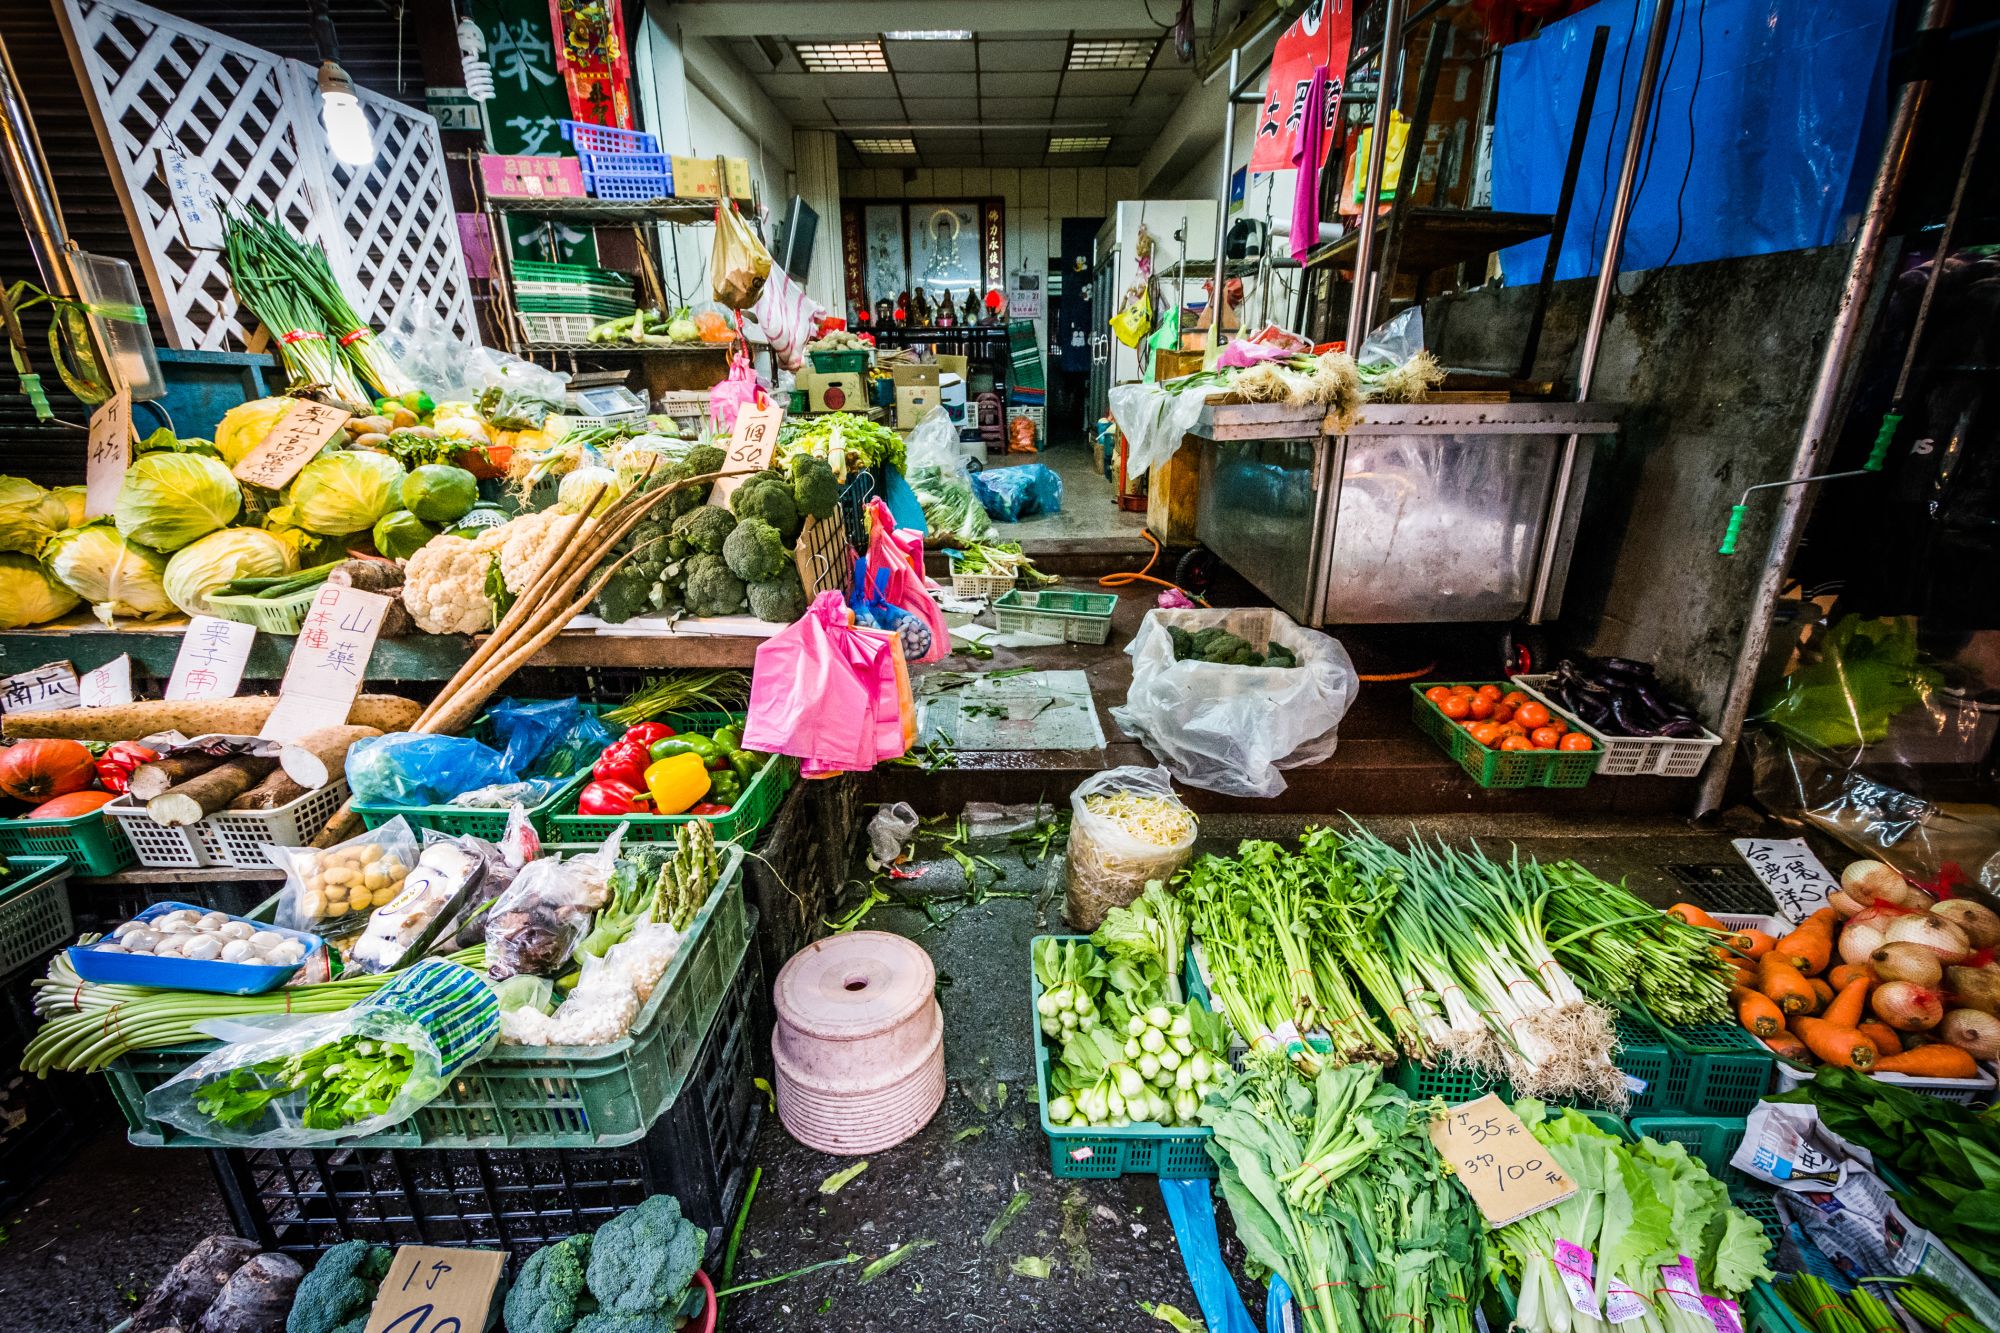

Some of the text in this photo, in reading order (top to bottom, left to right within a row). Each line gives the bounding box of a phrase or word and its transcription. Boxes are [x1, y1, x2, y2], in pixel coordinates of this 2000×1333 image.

[303, 589, 341, 650] 日本種
[316, 606, 373, 677] 山藥
[4, 673, 76, 708] 南瓜
